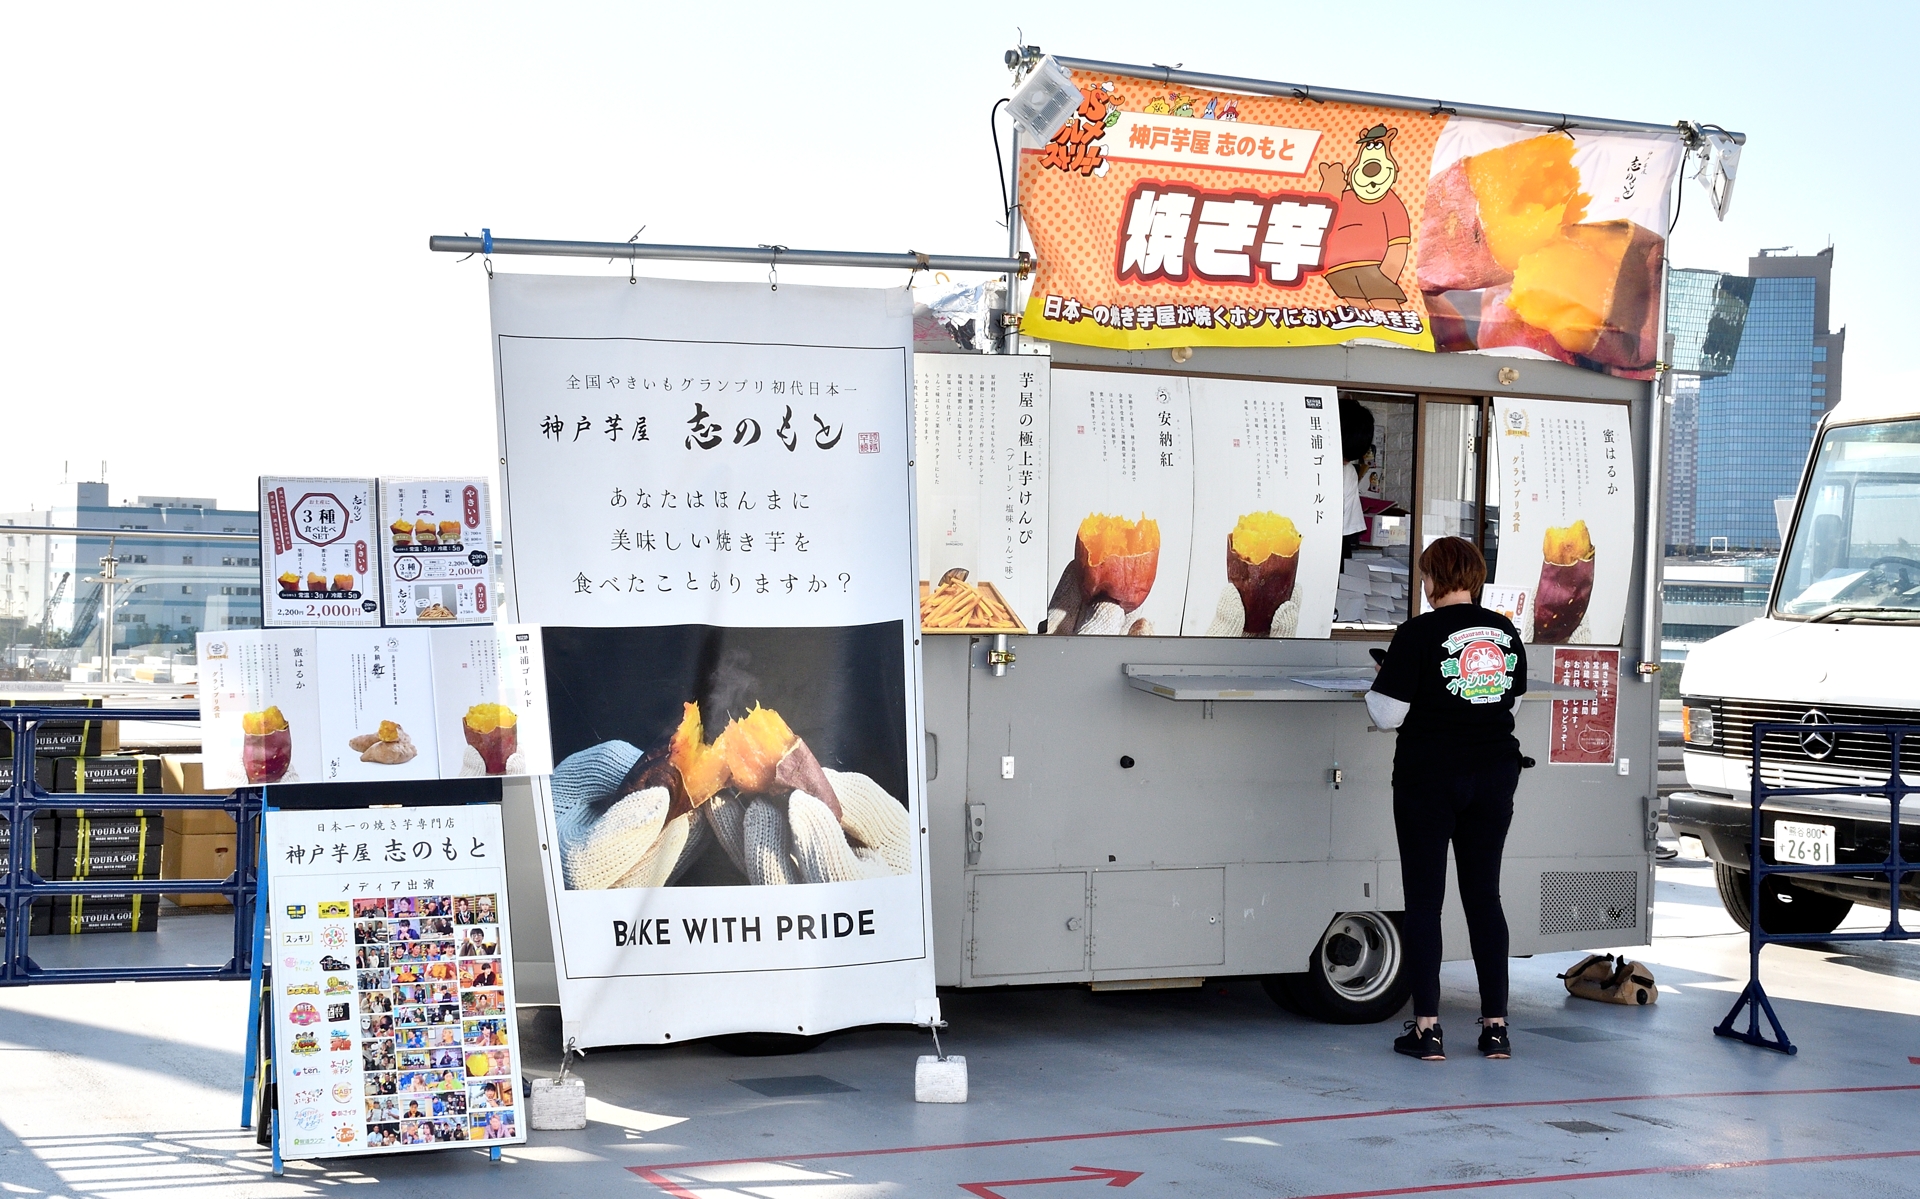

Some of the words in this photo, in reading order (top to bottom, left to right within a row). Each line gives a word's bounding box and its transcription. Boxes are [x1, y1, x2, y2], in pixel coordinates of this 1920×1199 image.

[1129, 124, 1209, 154] 神戸芋屋
[1216, 130, 1296, 161] 志のもと
[1122, 189, 1334, 286] 焼き芋
[1043, 293, 1421, 330] 日本一の焼き芋屋が焼くホンマにおいしい焼き芋
[566, 374, 857, 397] 全国やきいもグランプリ初代日本一
[540, 415, 650, 443] 神戸芋屋
[684, 402, 844, 453] 志のもと
[1158, 411, 1174, 467] 安納紅
[1018, 372, 1034, 544] 芋屋の極上芋けんぴ
[1310, 416, 1326, 525] 里浦ゴールド
[1603, 429, 1618, 495] 蜜はるか
[466, 490, 476, 524] やきいも
[610, 487, 811, 512] あなたはほんまに
[1512, 456, 1521, 533] グランプリ受賞
[303, 509, 336, 525] 3種
[612, 529, 811, 552] 美味しい焼き芋を
[357, 543, 365, 572] やきいも
[449, 568, 482, 576] 2,000円
[572, 572, 852, 595] 食べたことありますか？
[306, 605, 361, 618] 2,000円
[1453, 630, 1484, 642] Restaurant
[294, 648, 306, 689] 蜜はるか
[520, 645, 532, 707] 里浦ゴールド
[1442, 659, 1459, 676] 高
[1465, 688, 1489, 696] BRAZIL
[1572, 661, 1580, 728] お日持します。
[1582, 661, 1590, 715] 冷蔵で日間
[317, 817, 456, 833] 日本一の焼き芋専門店
[1806, 828, 1821, 839] 800
[285, 843, 371, 866] 神戸芋屋
[384, 836, 487, 863] 志のもと
[1788, 840, 1829, 863] 26-81
[341, 878, 435, 893] メディア出演
[286, 935, 310, 943] スッキリ
[613, 918, 670, 947] BAKE
[682, 916, 761, 944] WITH
[777, 909, 875, 941] PRIDE
